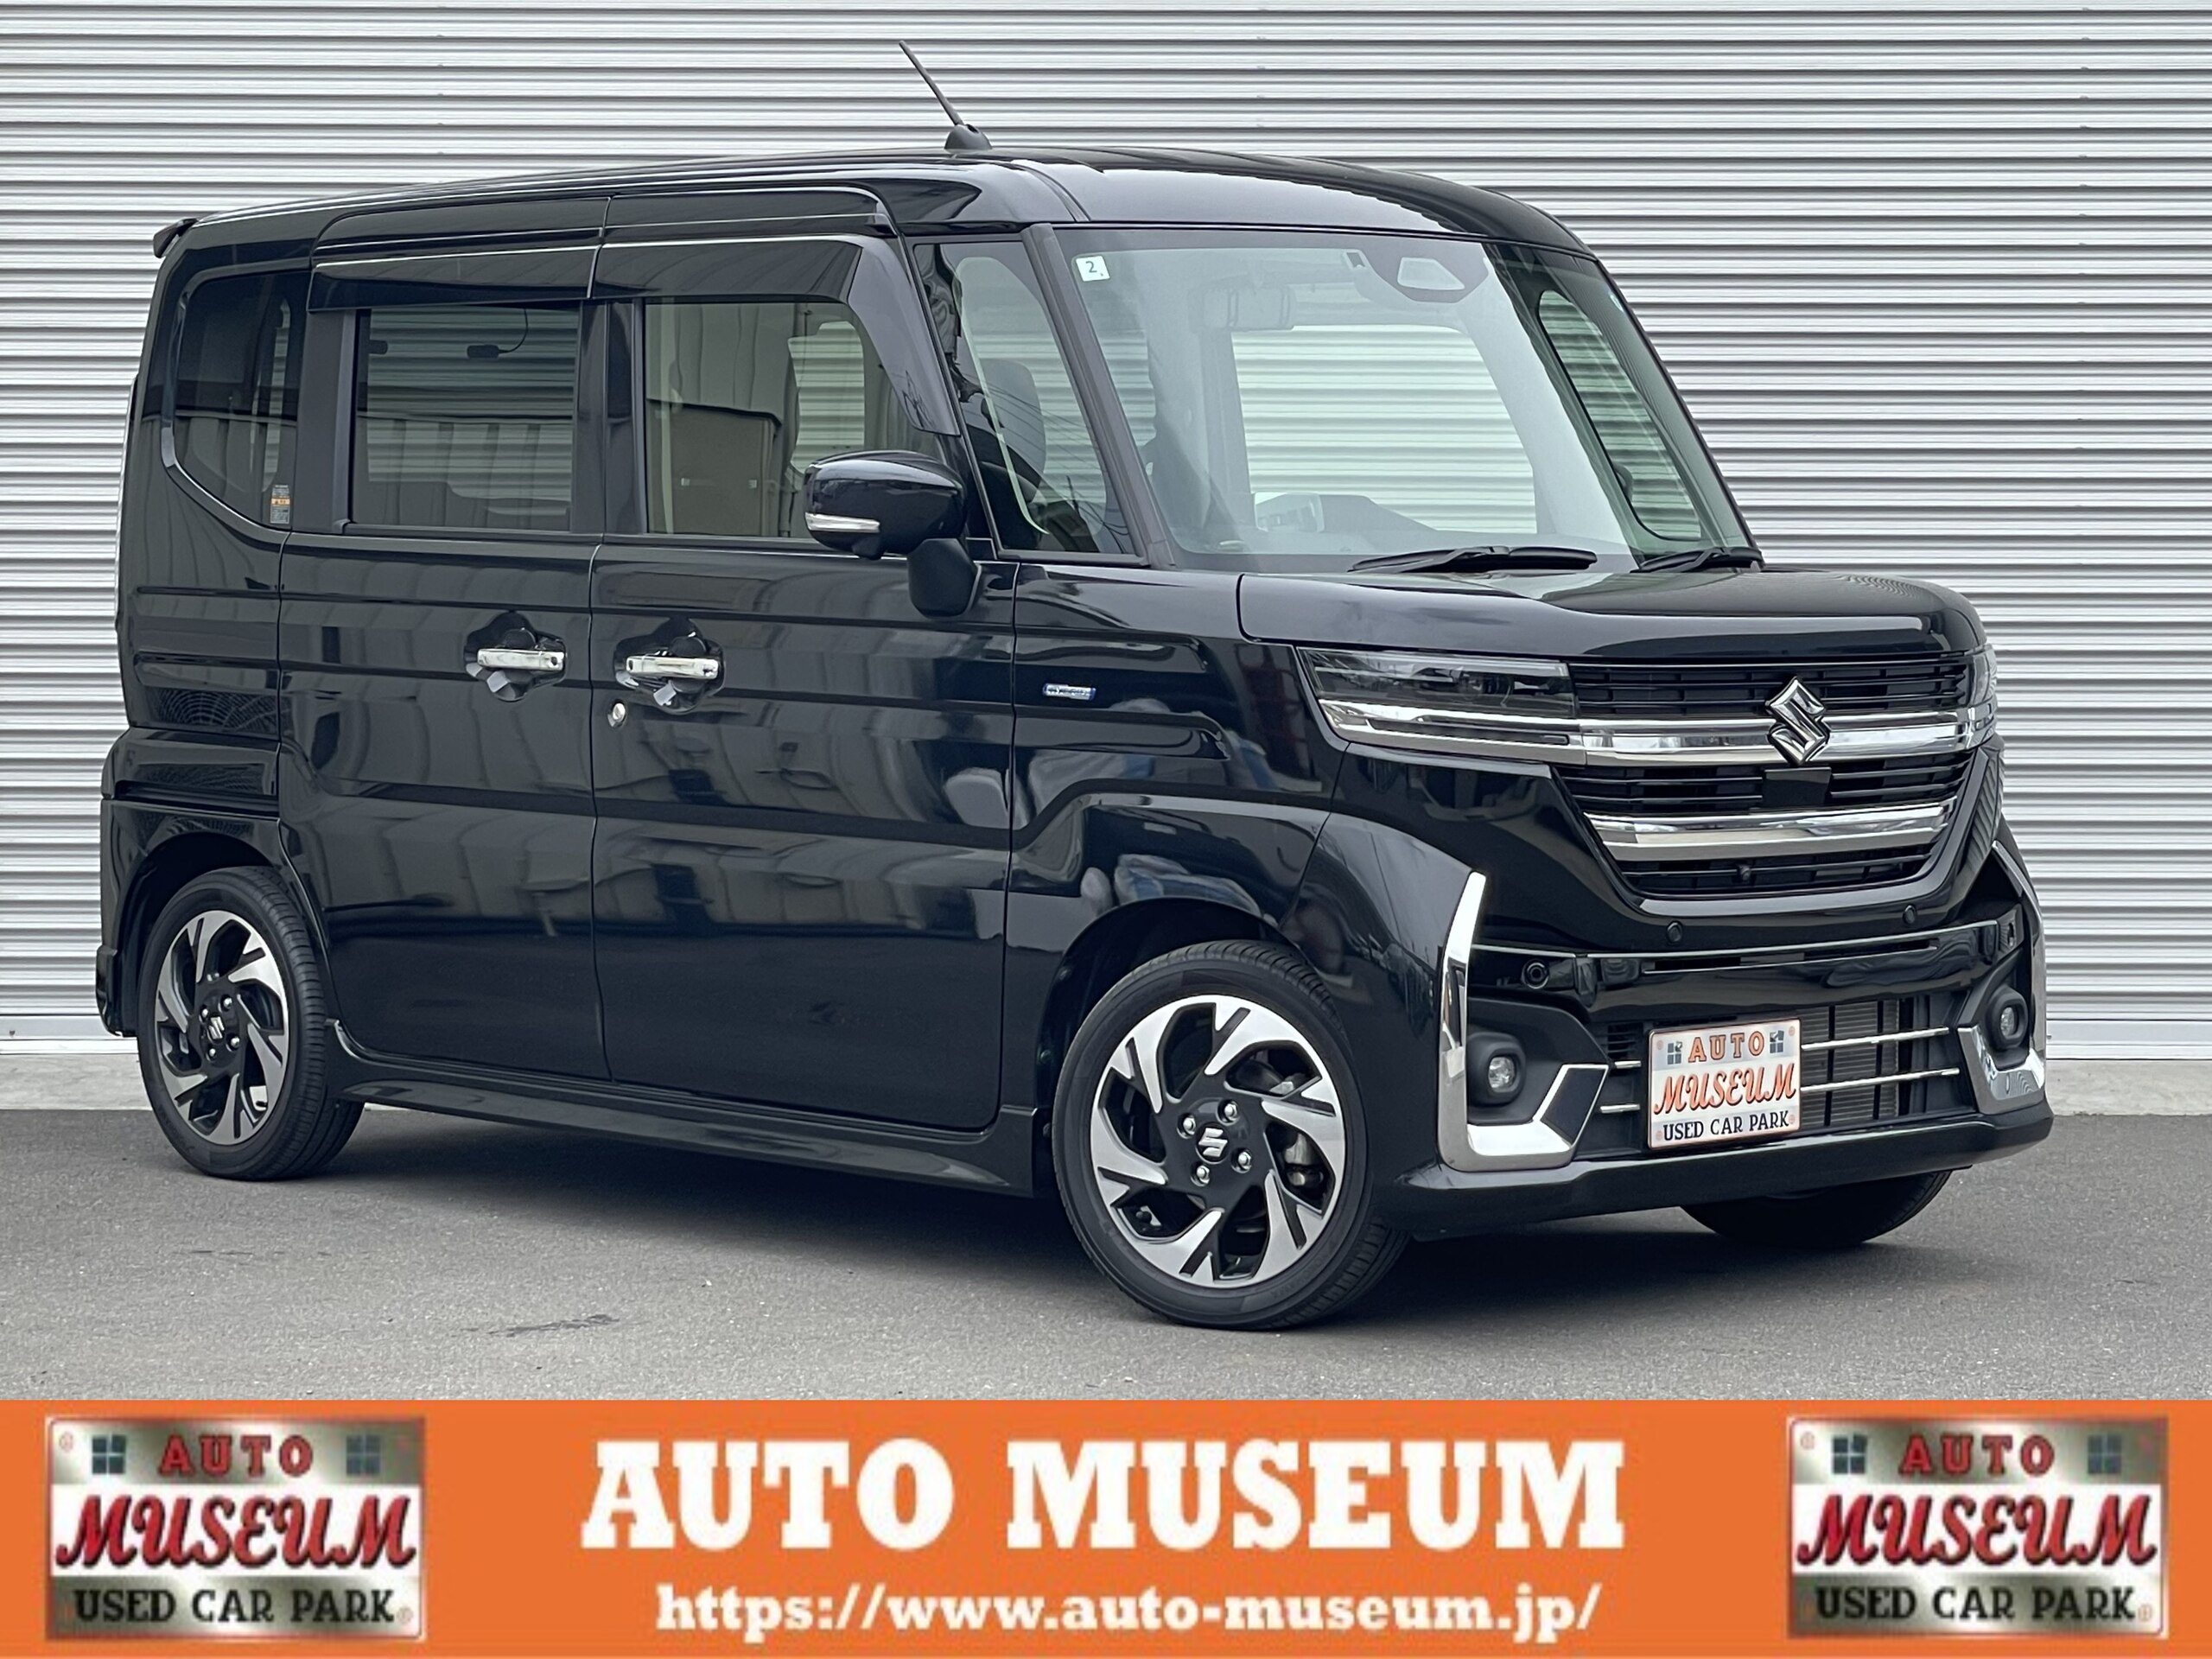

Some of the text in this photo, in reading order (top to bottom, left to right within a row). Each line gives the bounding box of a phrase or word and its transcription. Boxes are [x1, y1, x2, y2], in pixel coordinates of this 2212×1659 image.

[1085, 260, 1097, 273] 2
[1688, 1030, 1764, 1063] AUTO
[1653, 1063, 1796, 1115] MUSEUM
[1663, 1110, 1789, 1141] USED CAR PARK
